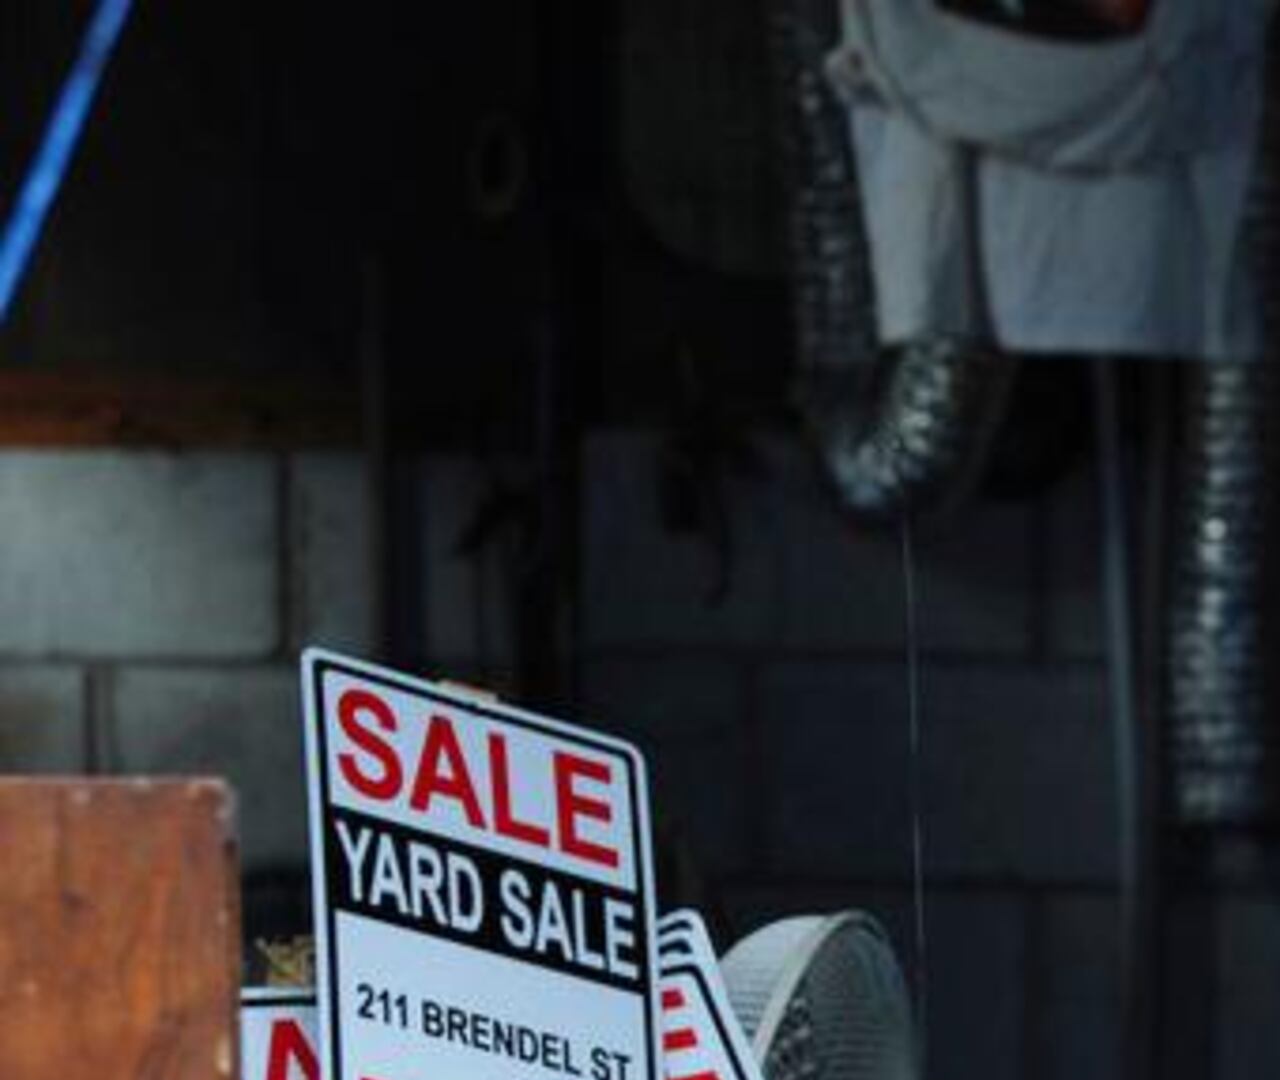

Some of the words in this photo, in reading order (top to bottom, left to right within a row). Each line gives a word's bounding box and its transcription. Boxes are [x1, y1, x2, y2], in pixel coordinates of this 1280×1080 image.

[338, 688, 619, 869] SALE
[334, 821, 484, 932] YARD
[500, 869, 639, 979] SALE
[356, 984, 408, 1029] 211
[421, 1000, 582, 1077] BRENDEL
